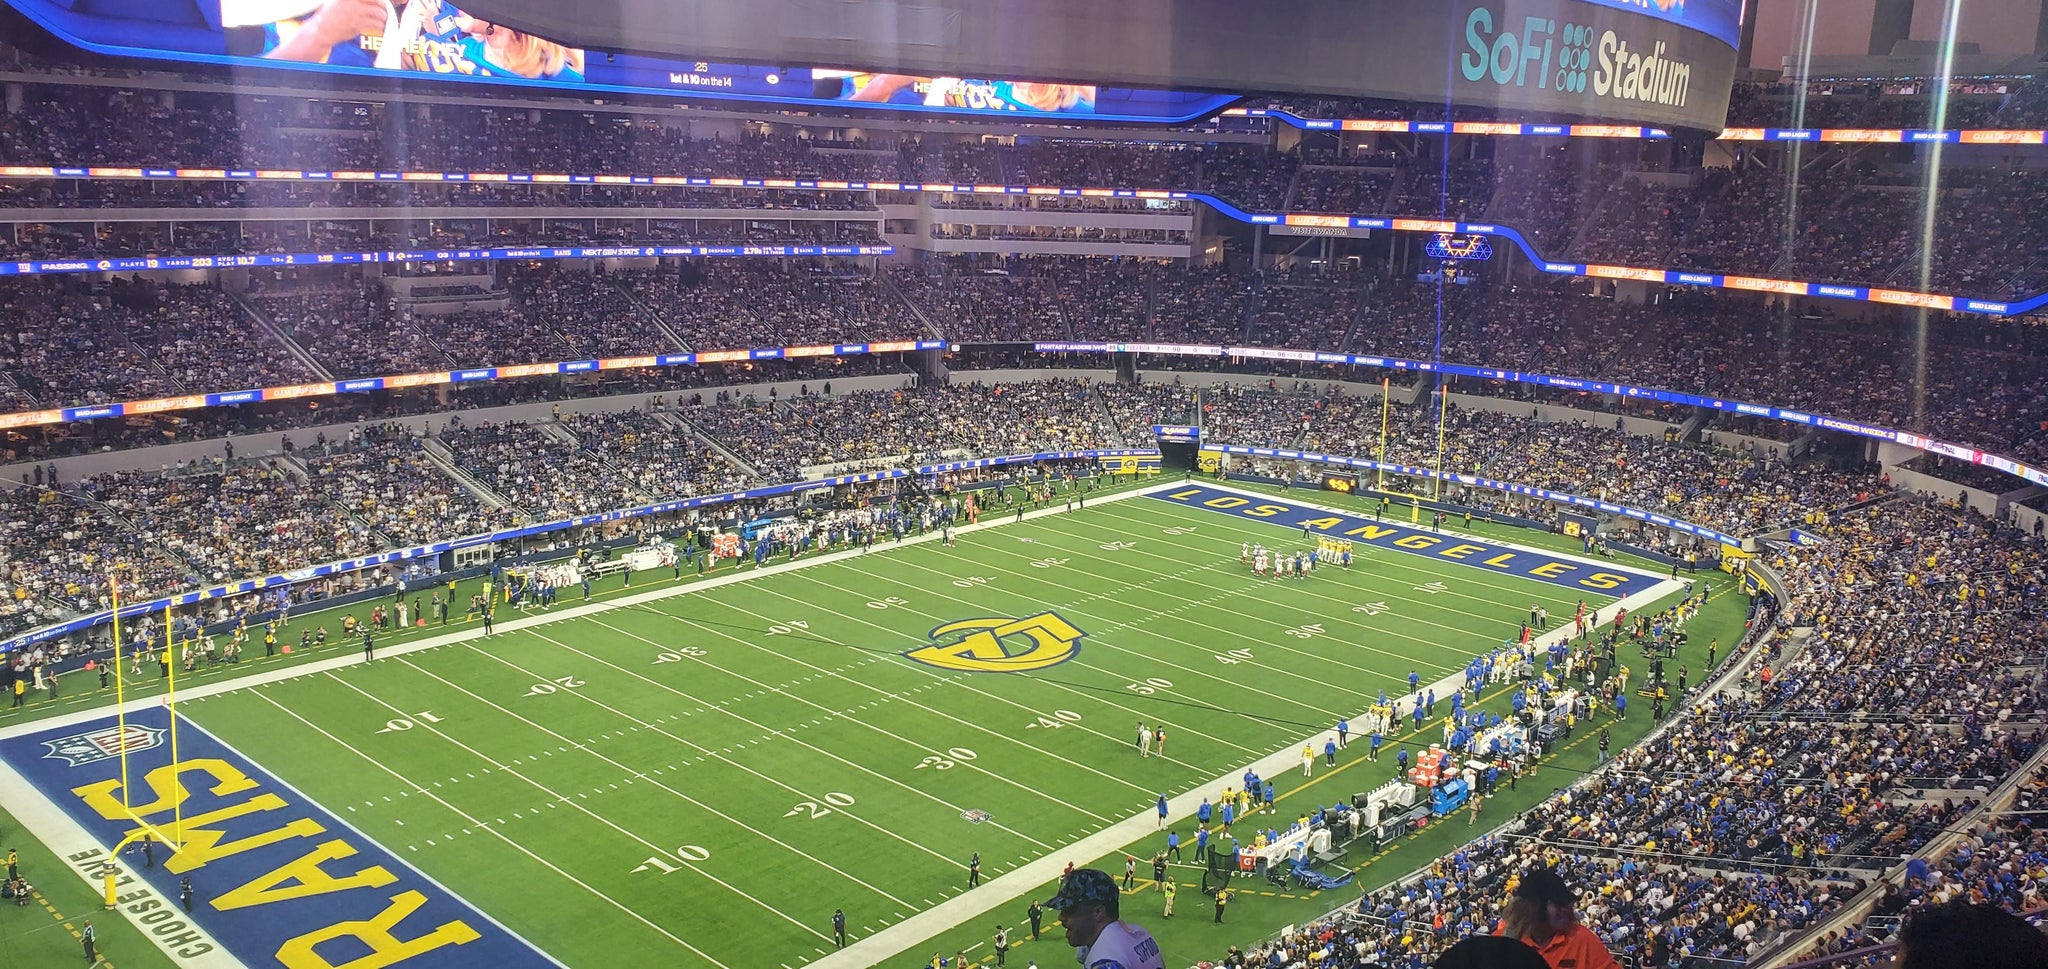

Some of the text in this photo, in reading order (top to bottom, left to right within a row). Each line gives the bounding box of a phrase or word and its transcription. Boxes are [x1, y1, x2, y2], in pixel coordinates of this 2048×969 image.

[1461, 7, 1690, 107] SoFi Stadium
[694, 62, 708, 72] :25
[690, 75, 700, 85] 10
[700, 78, 710, 86] on
[711, 77, 723, 86] the
[723, 77, 732, 87] 14
[1291, 227, 1347, 236] VISIT RWANDA
[41, 262, 88, 271] PASSING
[147, 259, 158, 268] 19
[192, 258, 212, 267] 203
[237, 256, 256, 265] 10.7
[286, 255, 293, 264] 2
[1835, 288, 1856, 296] LIGHT
[1984, 303, 2006, 311] LIGHT
[1752, 407, 1770, 415] LIGHT
[1780, 410, 1810, 422] BUD LIGHT
[1161, 427, 1190, 435] RAMS
[1823, 419, 1860, 432] SCORES
[1861, 427, 1887, 437] WEEK
[836, 458, 998, 485] RAMS HOUSE
[1328, 478, 1350, 491] 9:56
[1402, 467, 1544, 496] RAMS HOUSE
[1167, 489, 1290, 518] LOS
[1296, 517, 1630, 590] ANGELES
[1029, 556, 1060, 569] 30
[170, 546, 434, 606] RAMS HOUSE
[952, 575, 988, 589] 40
[1413, 580, 1448, 595] 10
[866, 596, 909, 610] 50
[1351, 601, 1390, 616] 20
[769, 618, 809, 635] 40
[1285, 623, 1326, 640] 30
[658, 646, 707, 664] 30
[1213, 647, 1255, 666] 40
[530, 675, 587, 696] 20
[1126, 677, 1174, 696] 50
[386, 709, 445, 731] 10
[1037, 709, 1082, 729] 40
[922, 746, 978, 771] 30
[793, 791, 856, 820] 20
[70, 757, 482, 969] RAMS
[643, 844, 711, 876] 10
[1243, 858, 1251, 866] G
[67, 848, 214, 959] CHOOSE LOVE
